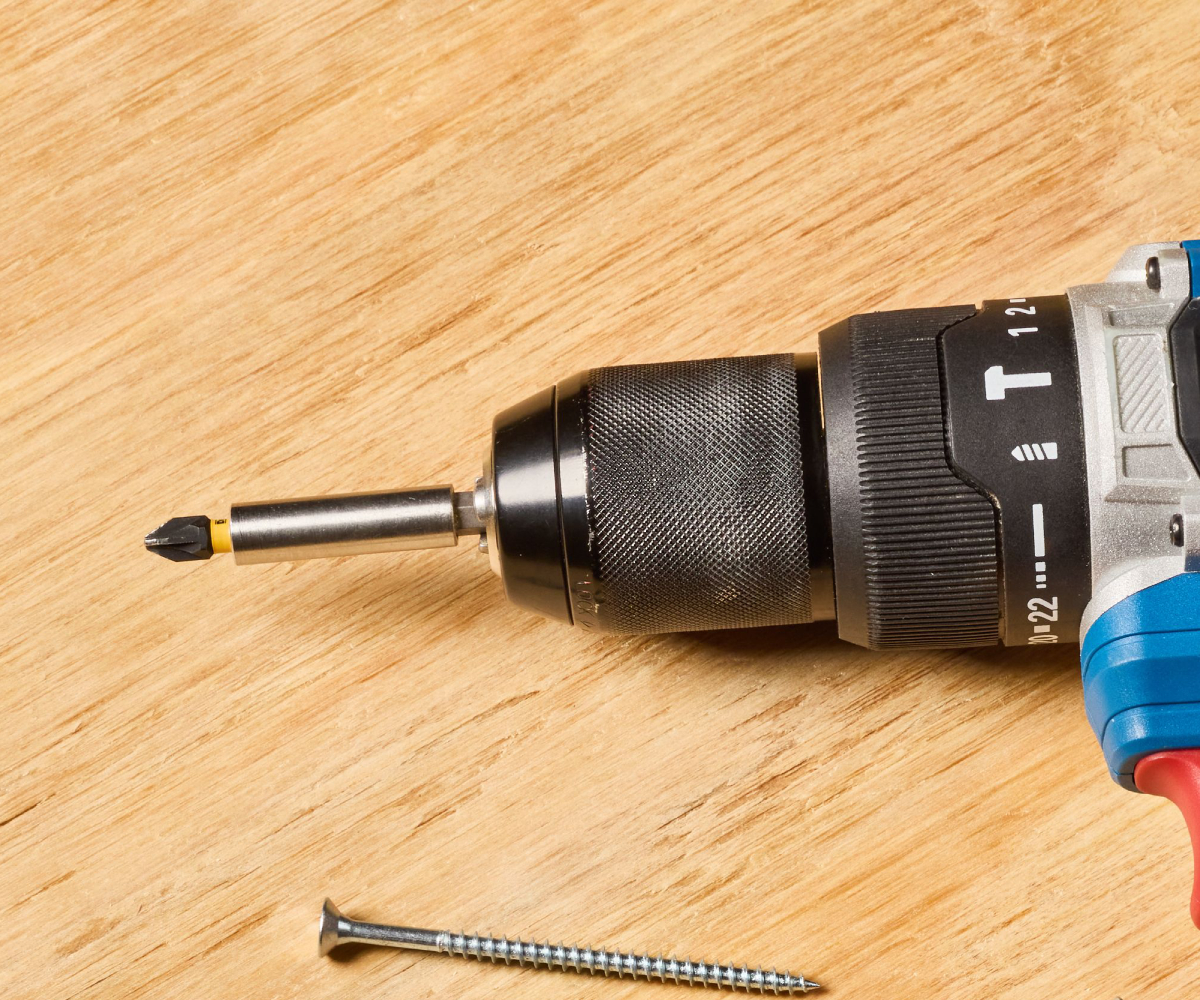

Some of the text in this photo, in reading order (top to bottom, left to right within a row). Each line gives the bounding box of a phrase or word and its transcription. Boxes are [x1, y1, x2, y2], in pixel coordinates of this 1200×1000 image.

[1005, 306, 1038, 337] 1 2
[1027, 596, 1058, 623] 22
